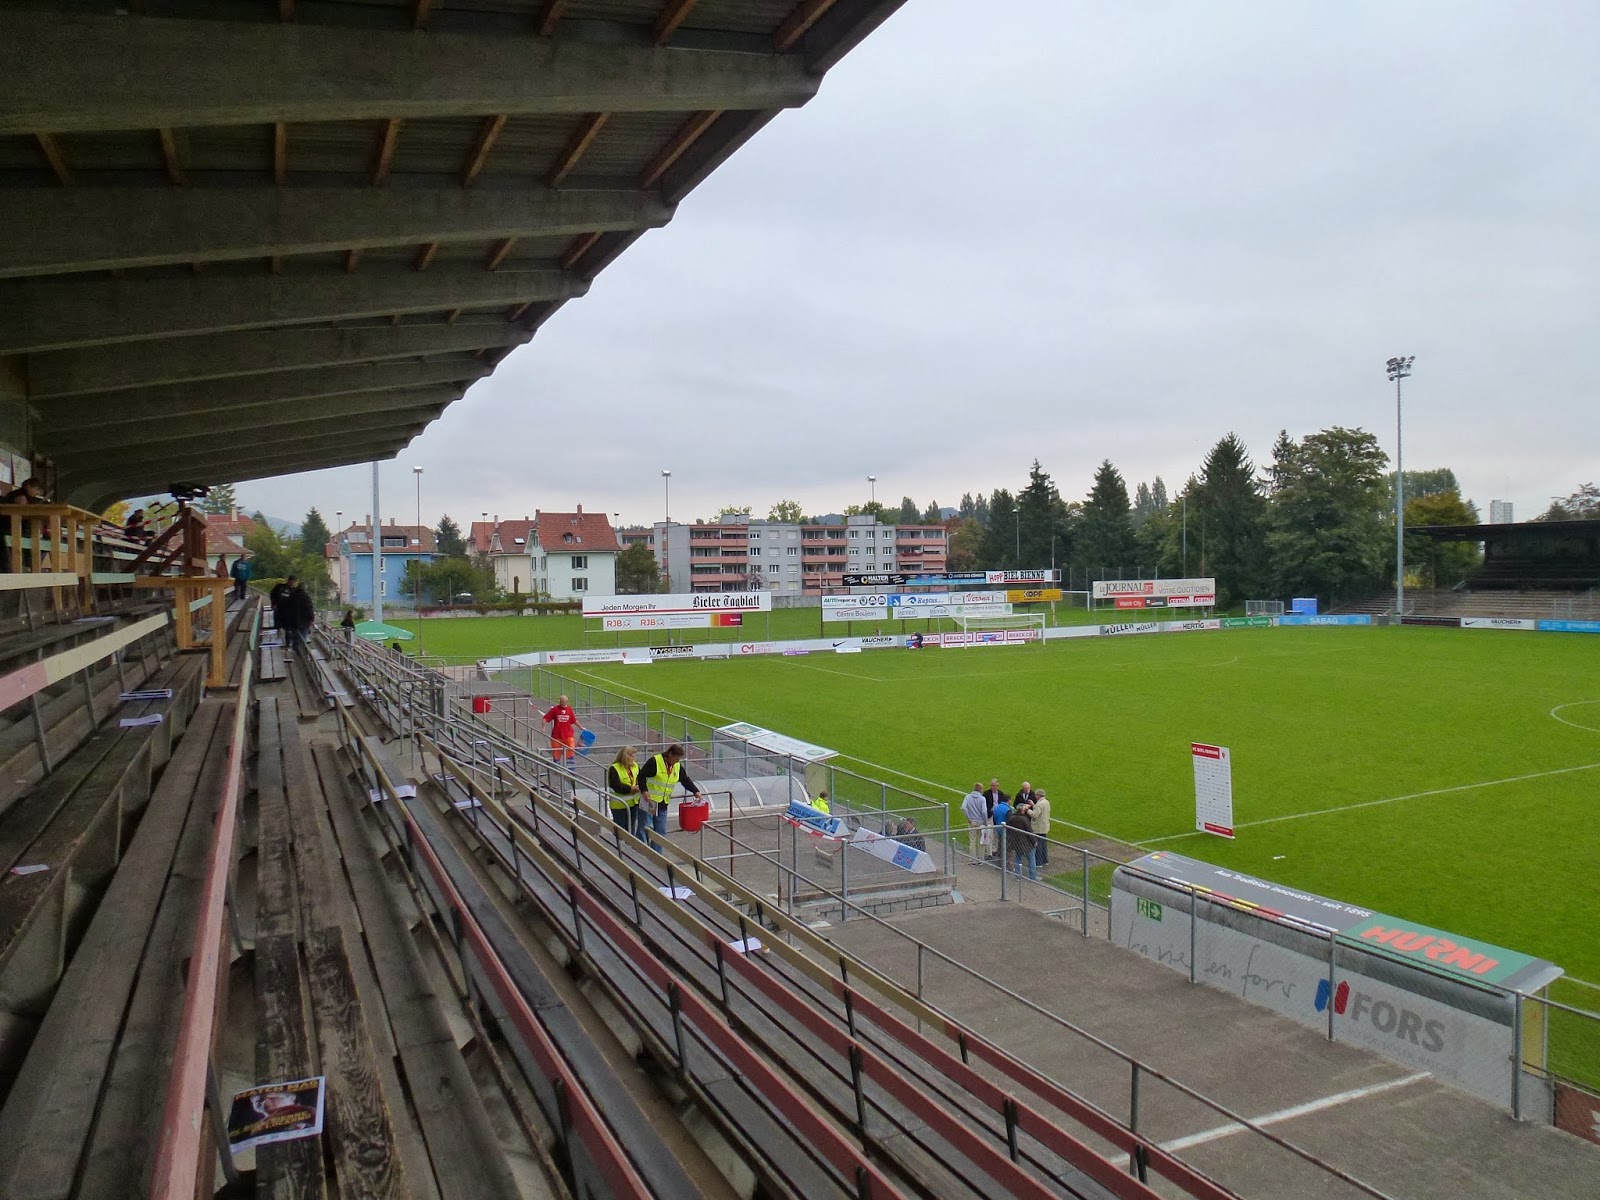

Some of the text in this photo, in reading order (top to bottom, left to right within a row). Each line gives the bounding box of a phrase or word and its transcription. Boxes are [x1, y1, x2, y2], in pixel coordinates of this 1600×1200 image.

[1004, 571, 1020, 580] BIEL
[1020, 570, 1045, 580] BIENNE
[1103, 582, 1144, 596] JOURNAL
[1176, 586, 1210, 594] QUOTIDIEN
[692, 594, 760, 608] Bieler Tagblatt
[622, 604, 648, 612] Morgen
[606, 620, 622, 628] RJB
[650, 647, 693, 655] WYSSBROD
[1214, 869, 1232, 878] Aus
[1232, 874, 1271, 890] Tradition
[1271, 884, 1315, 902] innovativ
[1321, 899, 1342, 912] seit
[1342, 905, 1372, 918] 1895
[1360, 925, 1499, 976] HURNI
[1350, 991, 1446, 1053] FORS
